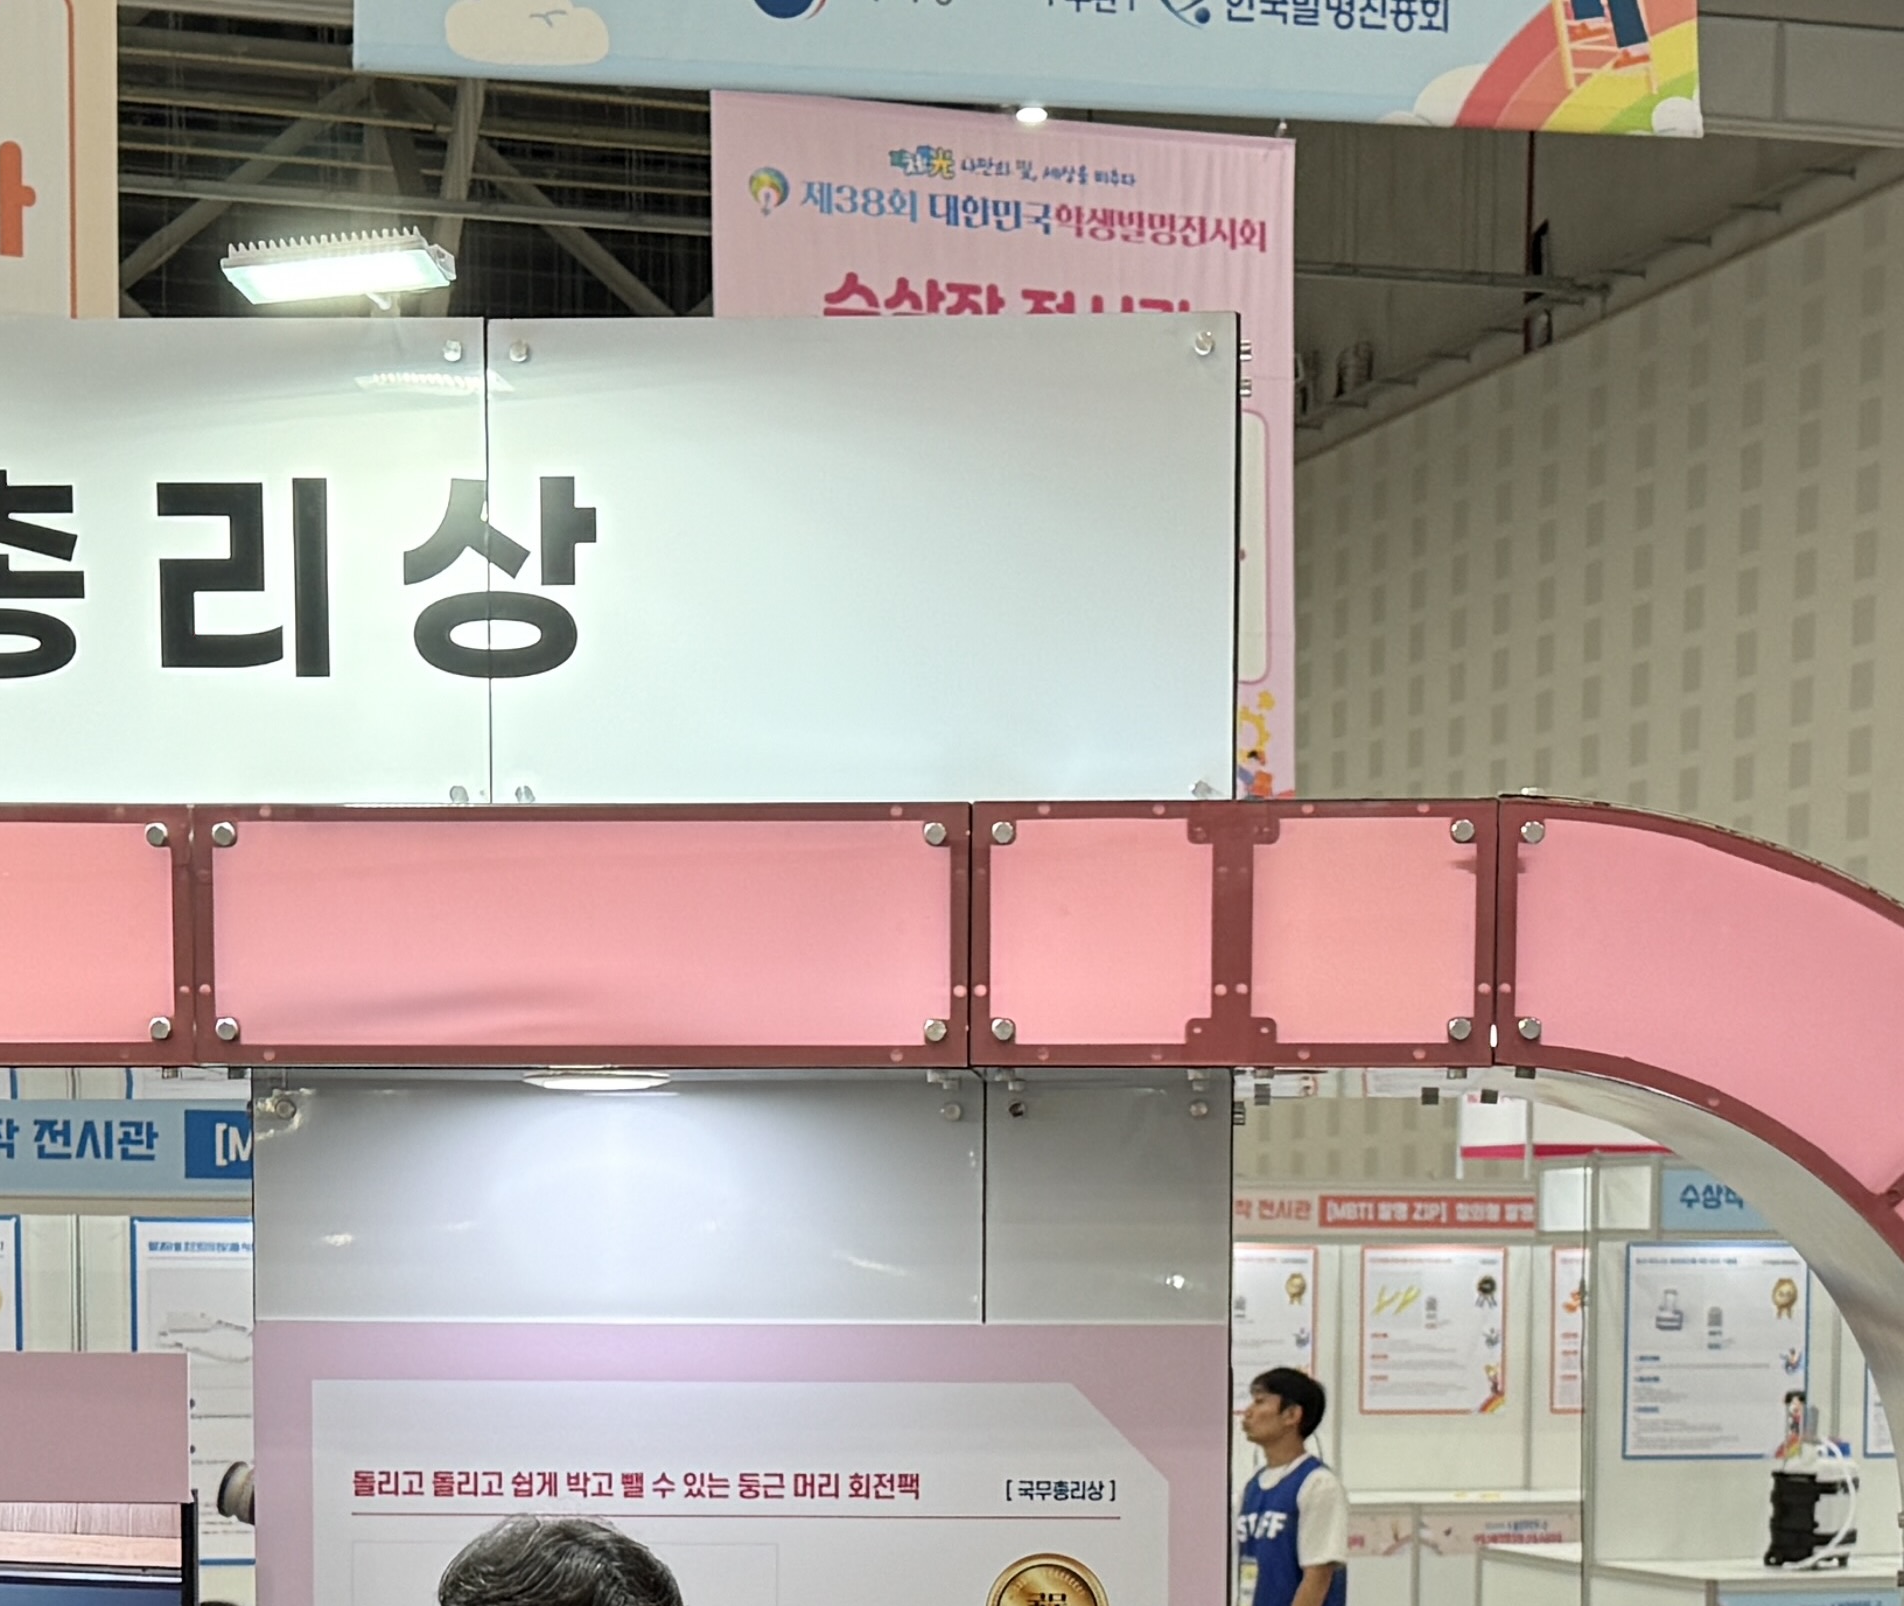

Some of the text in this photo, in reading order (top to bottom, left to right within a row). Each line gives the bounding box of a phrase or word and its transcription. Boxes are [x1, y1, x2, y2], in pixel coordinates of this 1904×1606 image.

[802, 179, 919, 223] 제38회
[32, 1119, 159, 1161] 전시관
[352, 1469, 425, 1497] 돌리고
[431, 1470, 504, 1497] 돌리고
[510, 1470, 559, 1498] 쉽게
[566, 1471, 614, 1498] 박고
[652, 1472, 676, 1499] 수
[683, 1472, 730, 1500] 있는
[738, 1472, 785, 1500] 둥근
[794, 1472, 840, 1500] 머리
[848, 1472, 921, 1501] 회전팩
